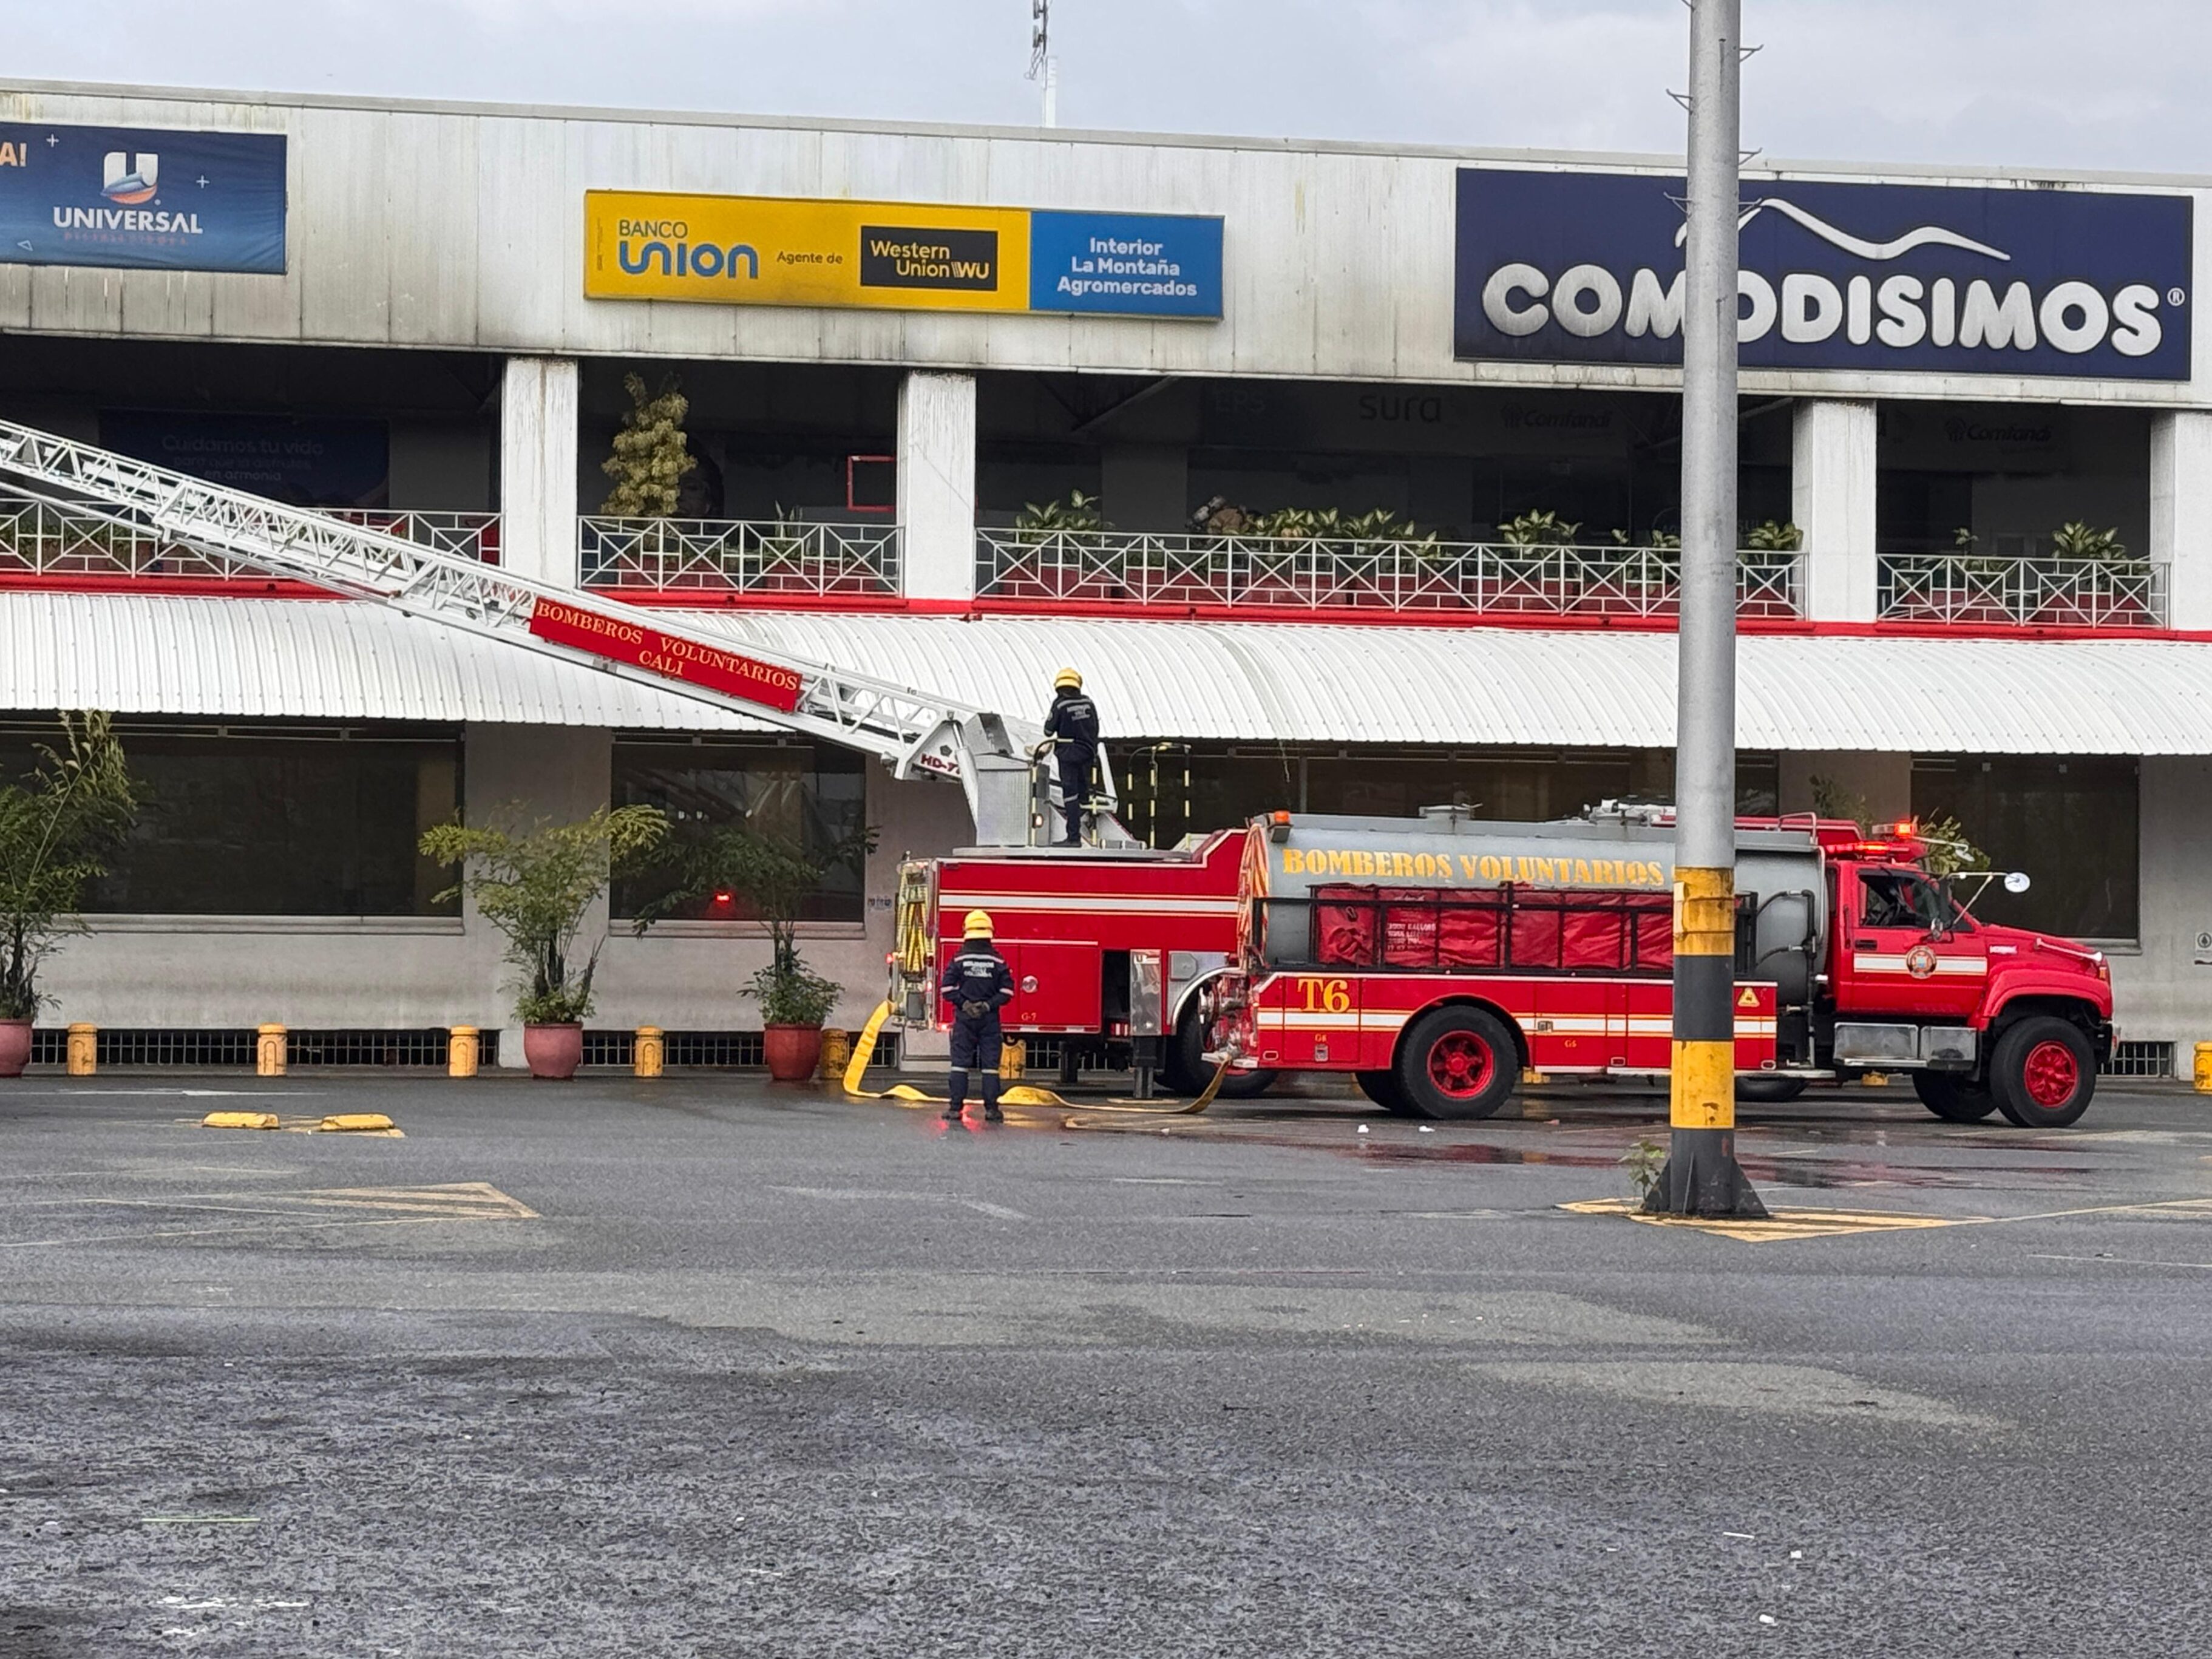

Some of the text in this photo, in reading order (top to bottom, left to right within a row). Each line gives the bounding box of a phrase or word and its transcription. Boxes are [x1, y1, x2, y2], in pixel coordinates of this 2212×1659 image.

[53, 206, 203, 234] UNIVERSAL
[619, 220, 688, 239] BANCO
[870, 240, 951, 260] Western
[1090, 237, 1164, 256] Interior
[776, 251, 843, 265] Agente de
[896, 259, 950, 277] Union
[1071, 256, 1180, 276] La Montaña
[1057, 276, 1198, 296] Agromercados
[1481, 263, 2163, 356] COMODISIMOS
[1358, 394, 1442, 423] sura
[1524, 409, 1613, 428] Comfandi
[161, 434, 256, 454] Cuidamos
[260, 438, 279, 453] tu
[537, 602, 799, 691] BOMBEROS VOLUNTARIOS
[639, 650, 685, 677] CALI
[1282, 849, 1454, 878] BOMBEROS
[1459, 854, 1664, 886] VOLUNTARIOS
[1297, 979, 1350, 1013] T6
